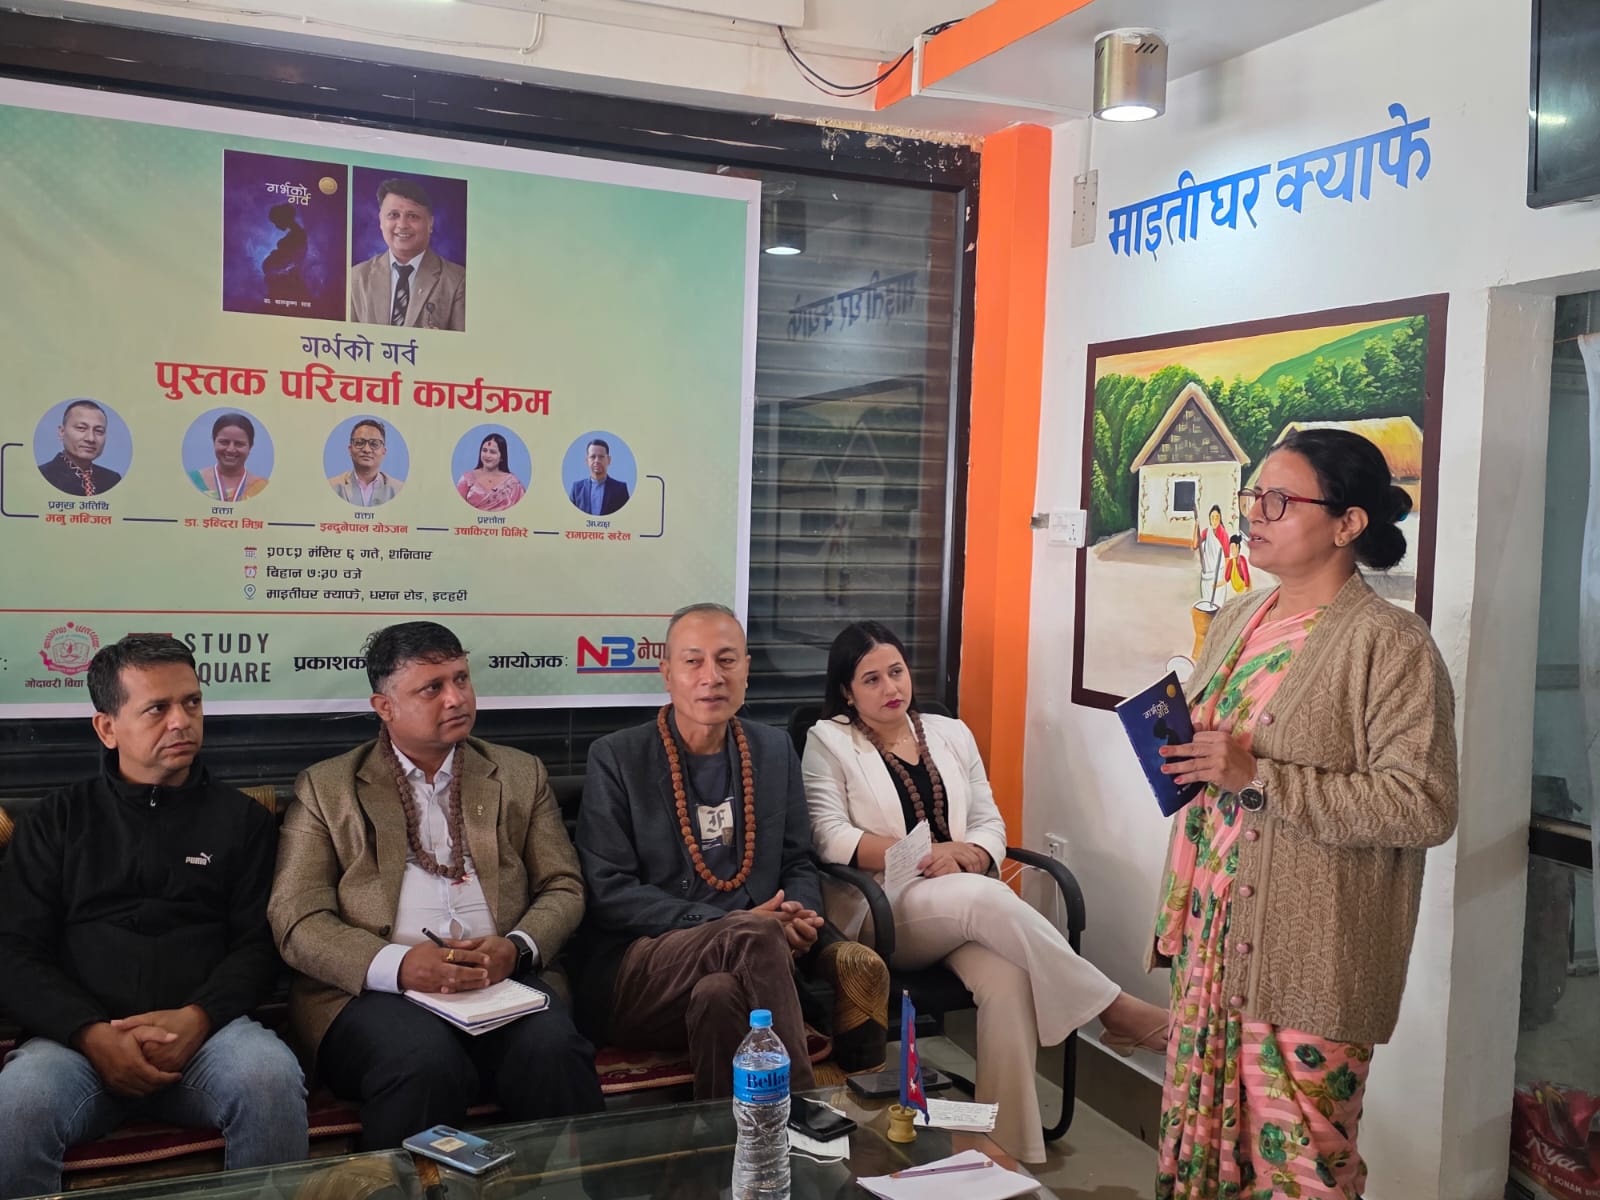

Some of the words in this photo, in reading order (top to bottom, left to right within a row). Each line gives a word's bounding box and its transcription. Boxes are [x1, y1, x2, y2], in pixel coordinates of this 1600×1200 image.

[265, 181, 307, 196] गर्भको
[1109, 164, 1272, 262] माइतीघर
[1276, 102, 1431, 214] क्याफे
[287, 193, 312, 206] गर्व
[300, 332, 374, 362] गर्भको
[381, 339, 419, 366] गर्व
[154, 361, 268, 400] पुस्तक
[279, 362, 403, 406] परिचर्चा
[413, 377, 553, 416] कार्यक्रम
[48, 501, 75, 512] प्रमुख
[79, 500, 110, 511] अतिथि
[211, 506, 234, 515] वक्ता
[45, 513, 66, 525] मनु
[354, 511, 375, 520] वक्ता
[202, 517, 239, 529] इन्दिरा
[585, 519, 611, 529] अध्यक्ष
[454, 525, 499, 537] उषाकिरण
[501, 526, 529, 538] घिमिरे
[565, 530, 605, 541] रामप्रसाद
[607, 530, 632, 541] खरेल
[308, 545, 342, 559] मंसिर
[346, 549, 355, 560] ६
[389, 548, 433, 560] शनिवार
[266, 587, 318, 600] माइतीघर
[369, 589, 401, 601] धरान
[432, 589, 469, 602] इटहरी
[184, 632, 270, 654] STUDY
[637, 636, 667, 660] नेपा
[198, 661, 272, 687] QUARE
[25, 678, 62, 689] गोदावरी
